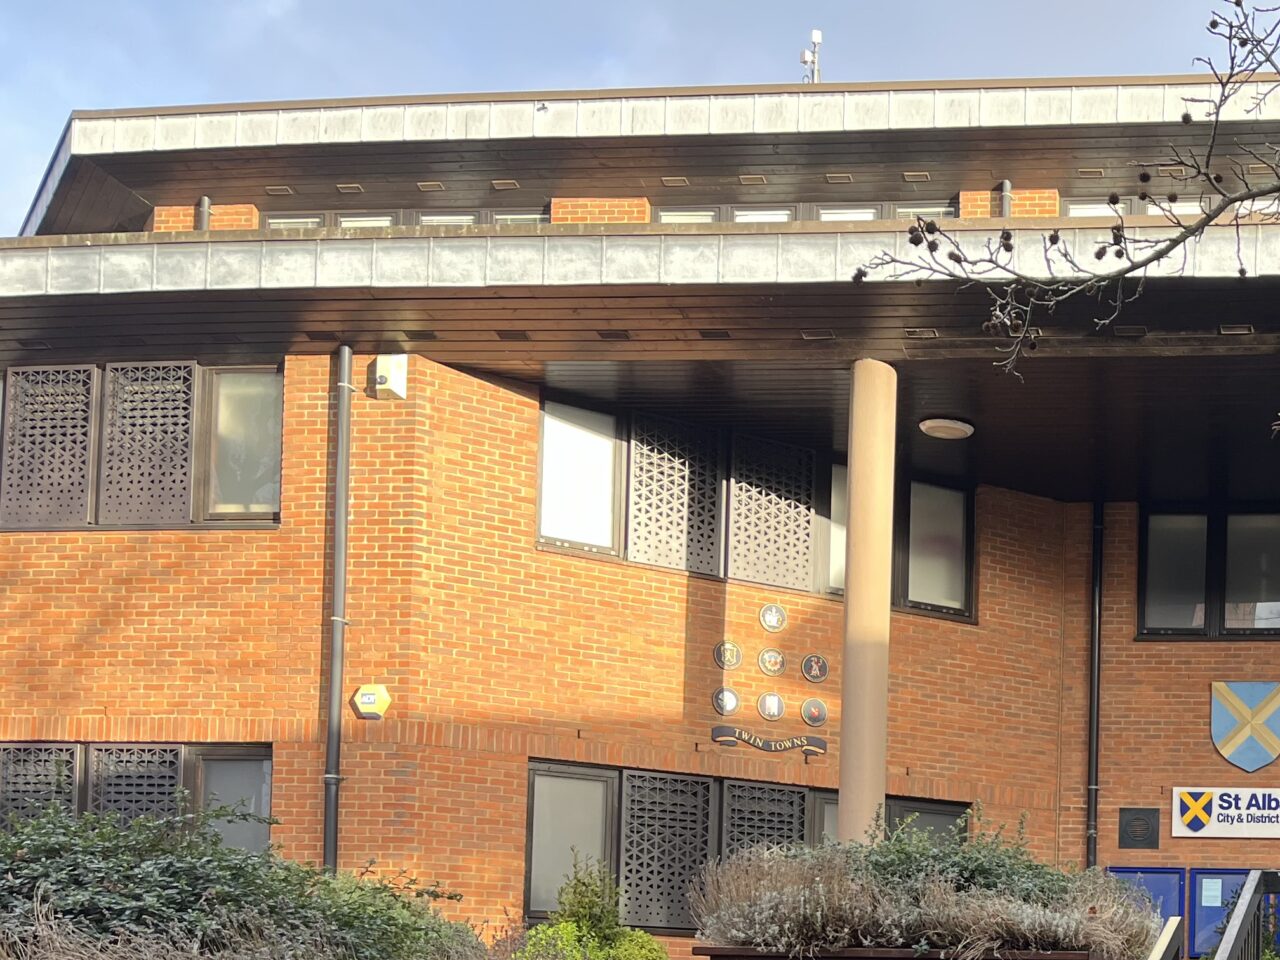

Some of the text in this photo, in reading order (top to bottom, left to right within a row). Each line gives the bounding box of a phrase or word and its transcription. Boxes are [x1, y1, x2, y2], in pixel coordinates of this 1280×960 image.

[734, 728, 807, 751] TWIN TOWNS
[1218, 792, 1241, 811] St
[1217, 813, 1235, 825] City
[1236, 814, 1244, 824] &
[1246, 813, 1280, 824] District
